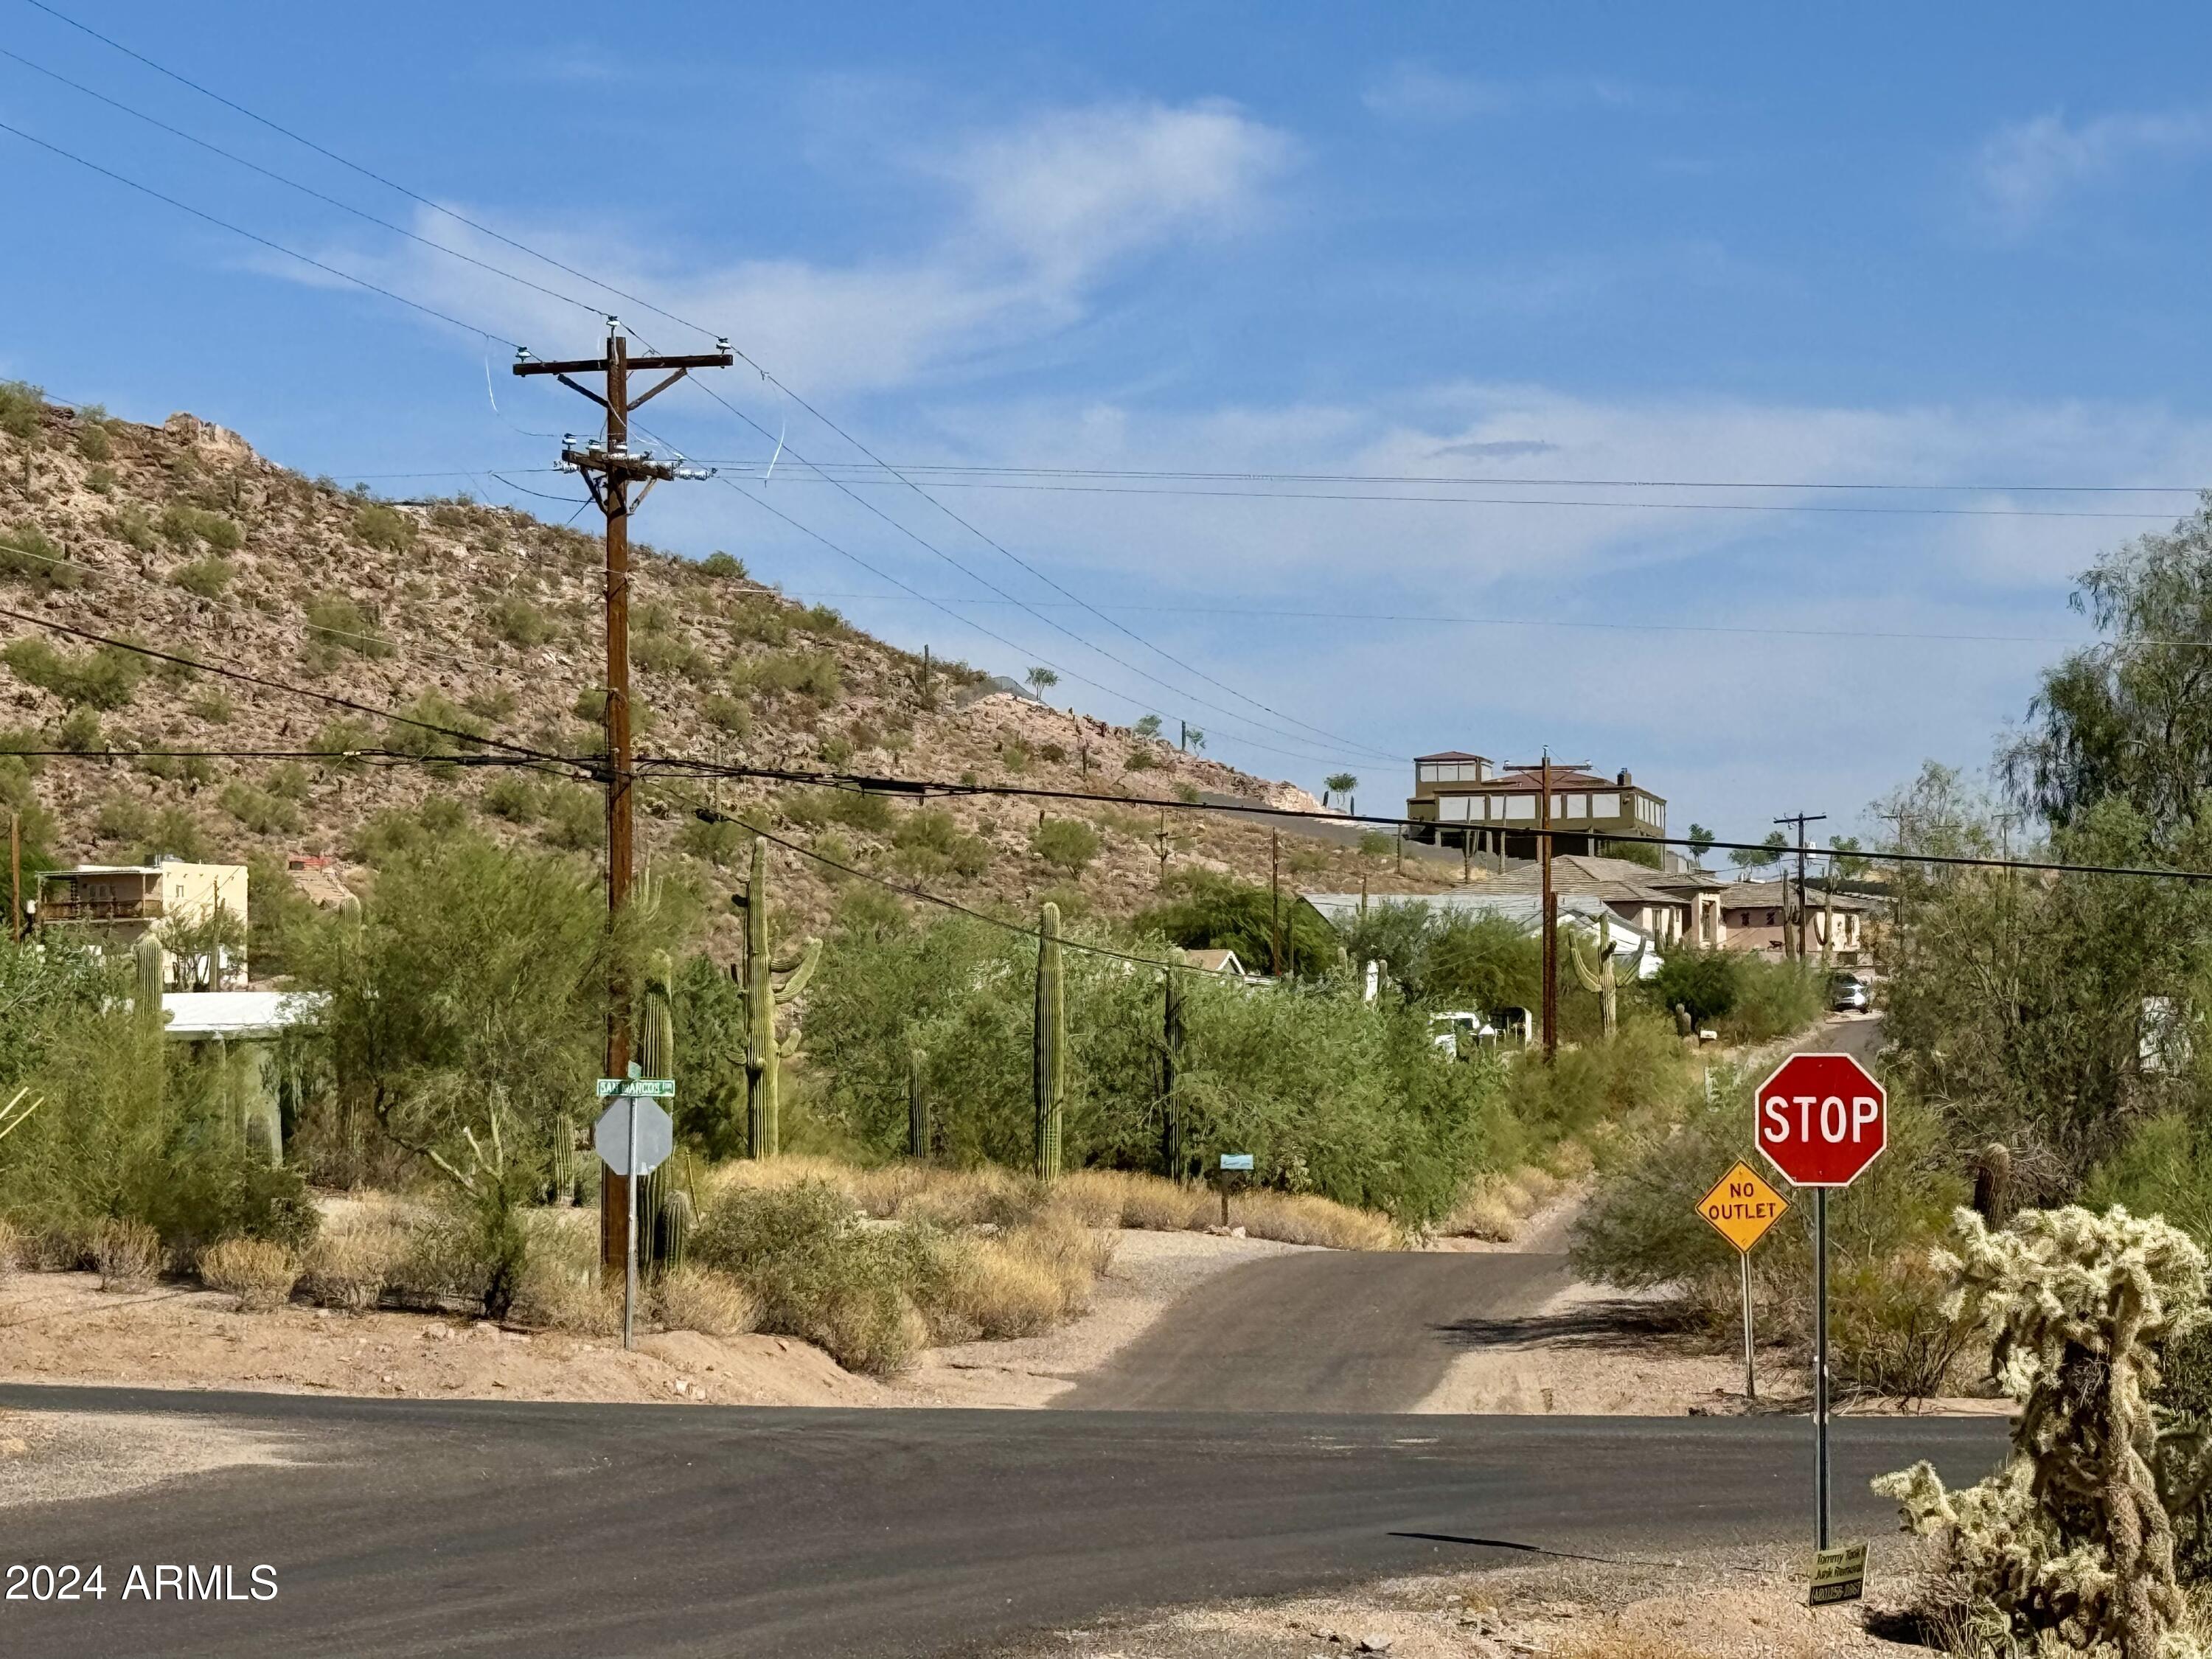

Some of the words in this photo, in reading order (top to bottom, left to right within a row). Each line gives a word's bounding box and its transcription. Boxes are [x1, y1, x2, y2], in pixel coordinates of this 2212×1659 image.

[1764, 1096, 1878, 1143] STOP
[1730, 1182, 1754, 1198] NO
[1708, 1203, 1776, 1220] OUTLET
